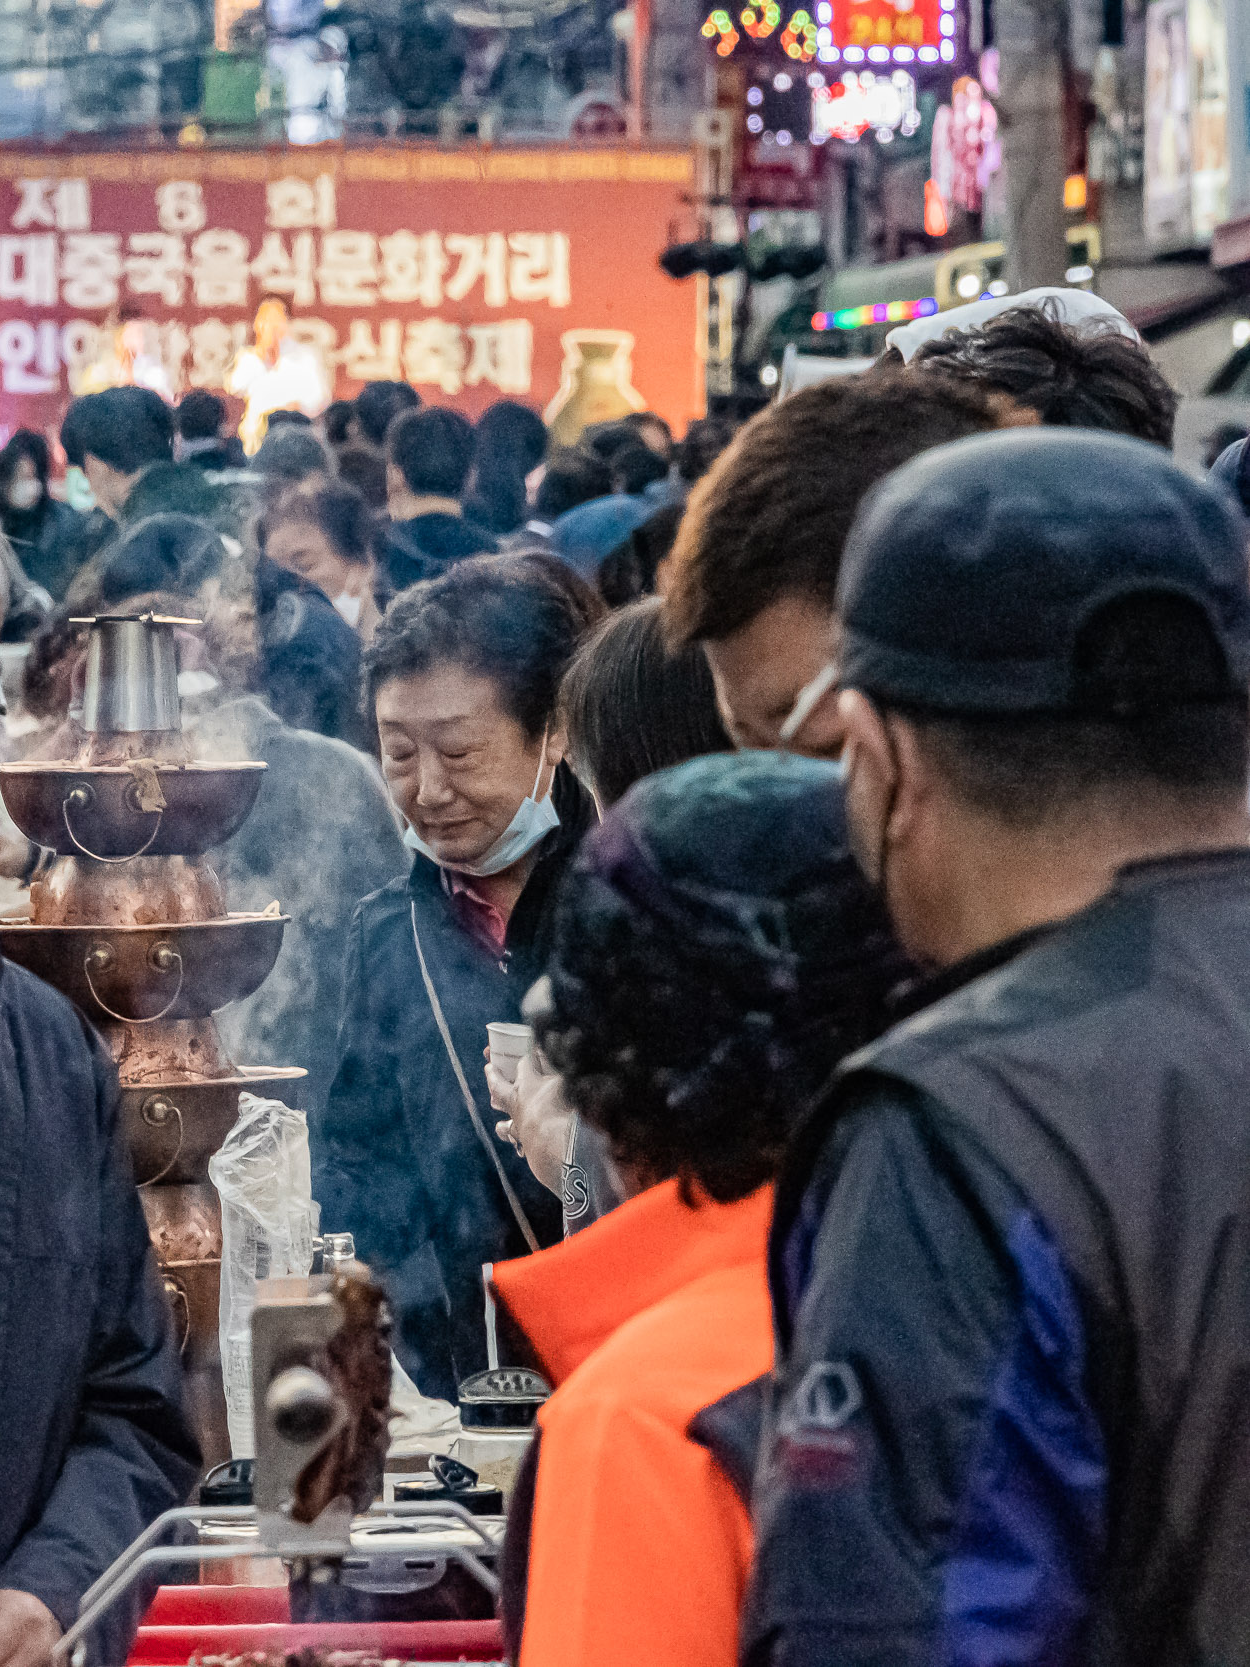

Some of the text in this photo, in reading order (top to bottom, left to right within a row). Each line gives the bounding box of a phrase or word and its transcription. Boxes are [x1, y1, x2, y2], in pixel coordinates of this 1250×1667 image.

[12, 177, 91, 231] 제
[265, 174, 337, 230] 회
[280, 316, 533, 394] 식축제
